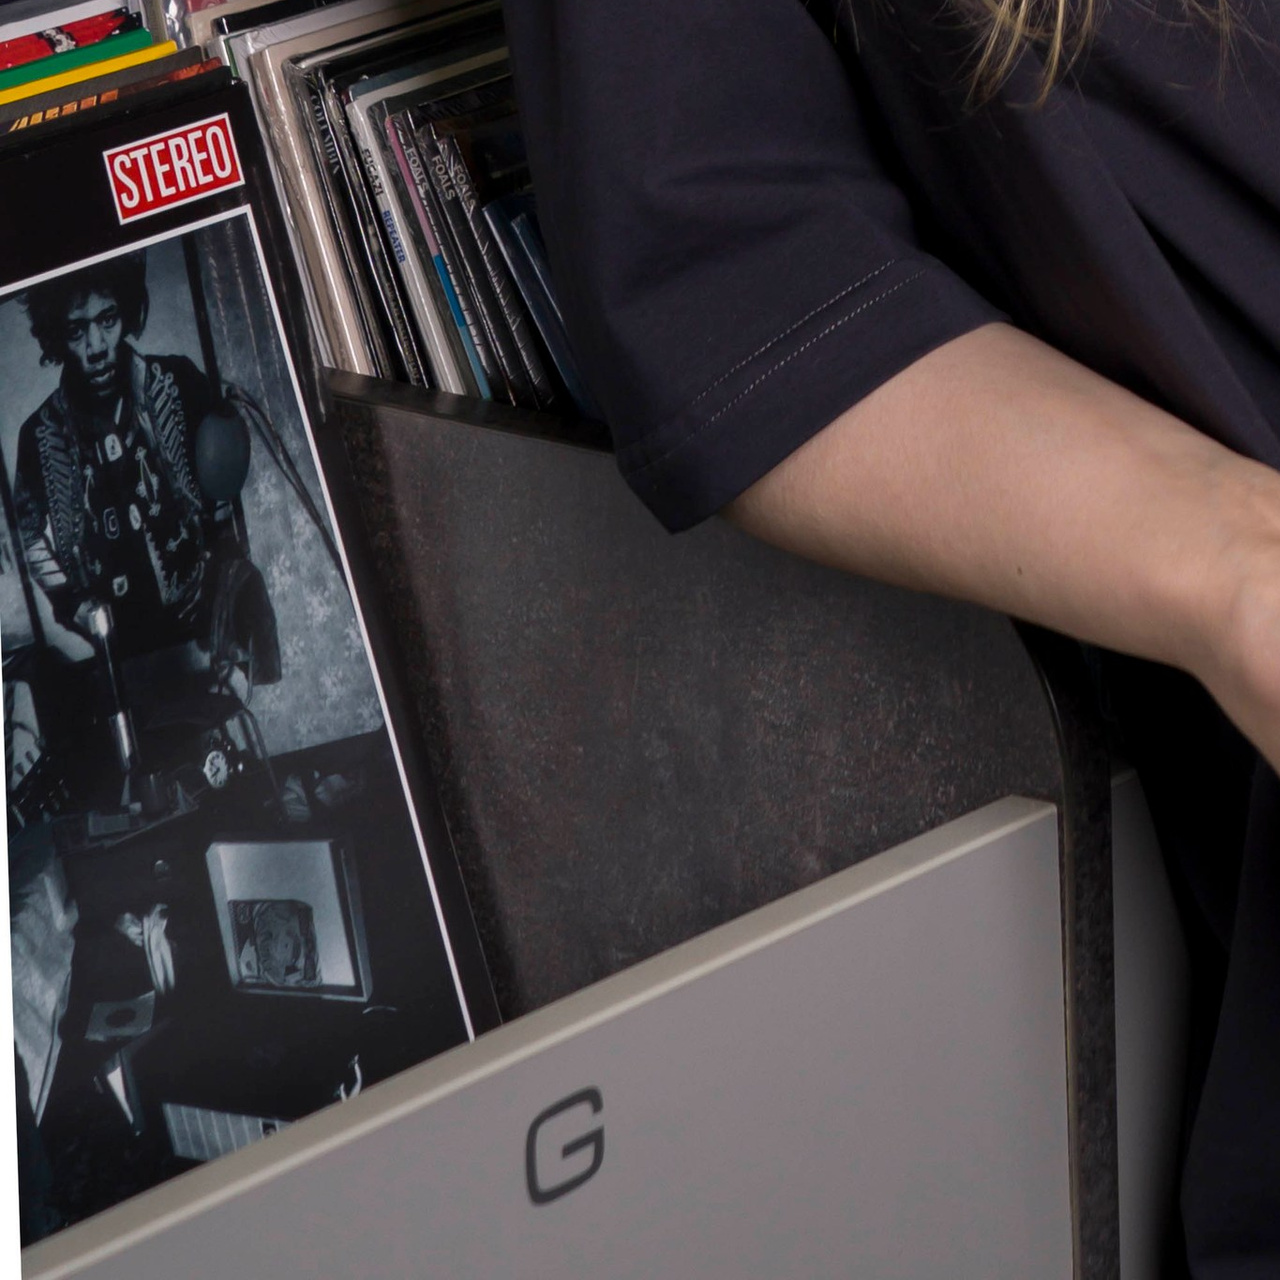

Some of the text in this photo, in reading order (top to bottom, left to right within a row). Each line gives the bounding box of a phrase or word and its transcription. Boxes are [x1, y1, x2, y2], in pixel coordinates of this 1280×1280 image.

[113, 124, 233, 209] STEREO
[405, 146, 429, 192] FOALS
[431, 154, 456, 202] FOALS
[451, 162, 477, 209] FOALS
[361, 147, 385, 198] FUGAZI
[382, 209, 407, 266] REPEATER
[525, 1085, 605, 1207] G
